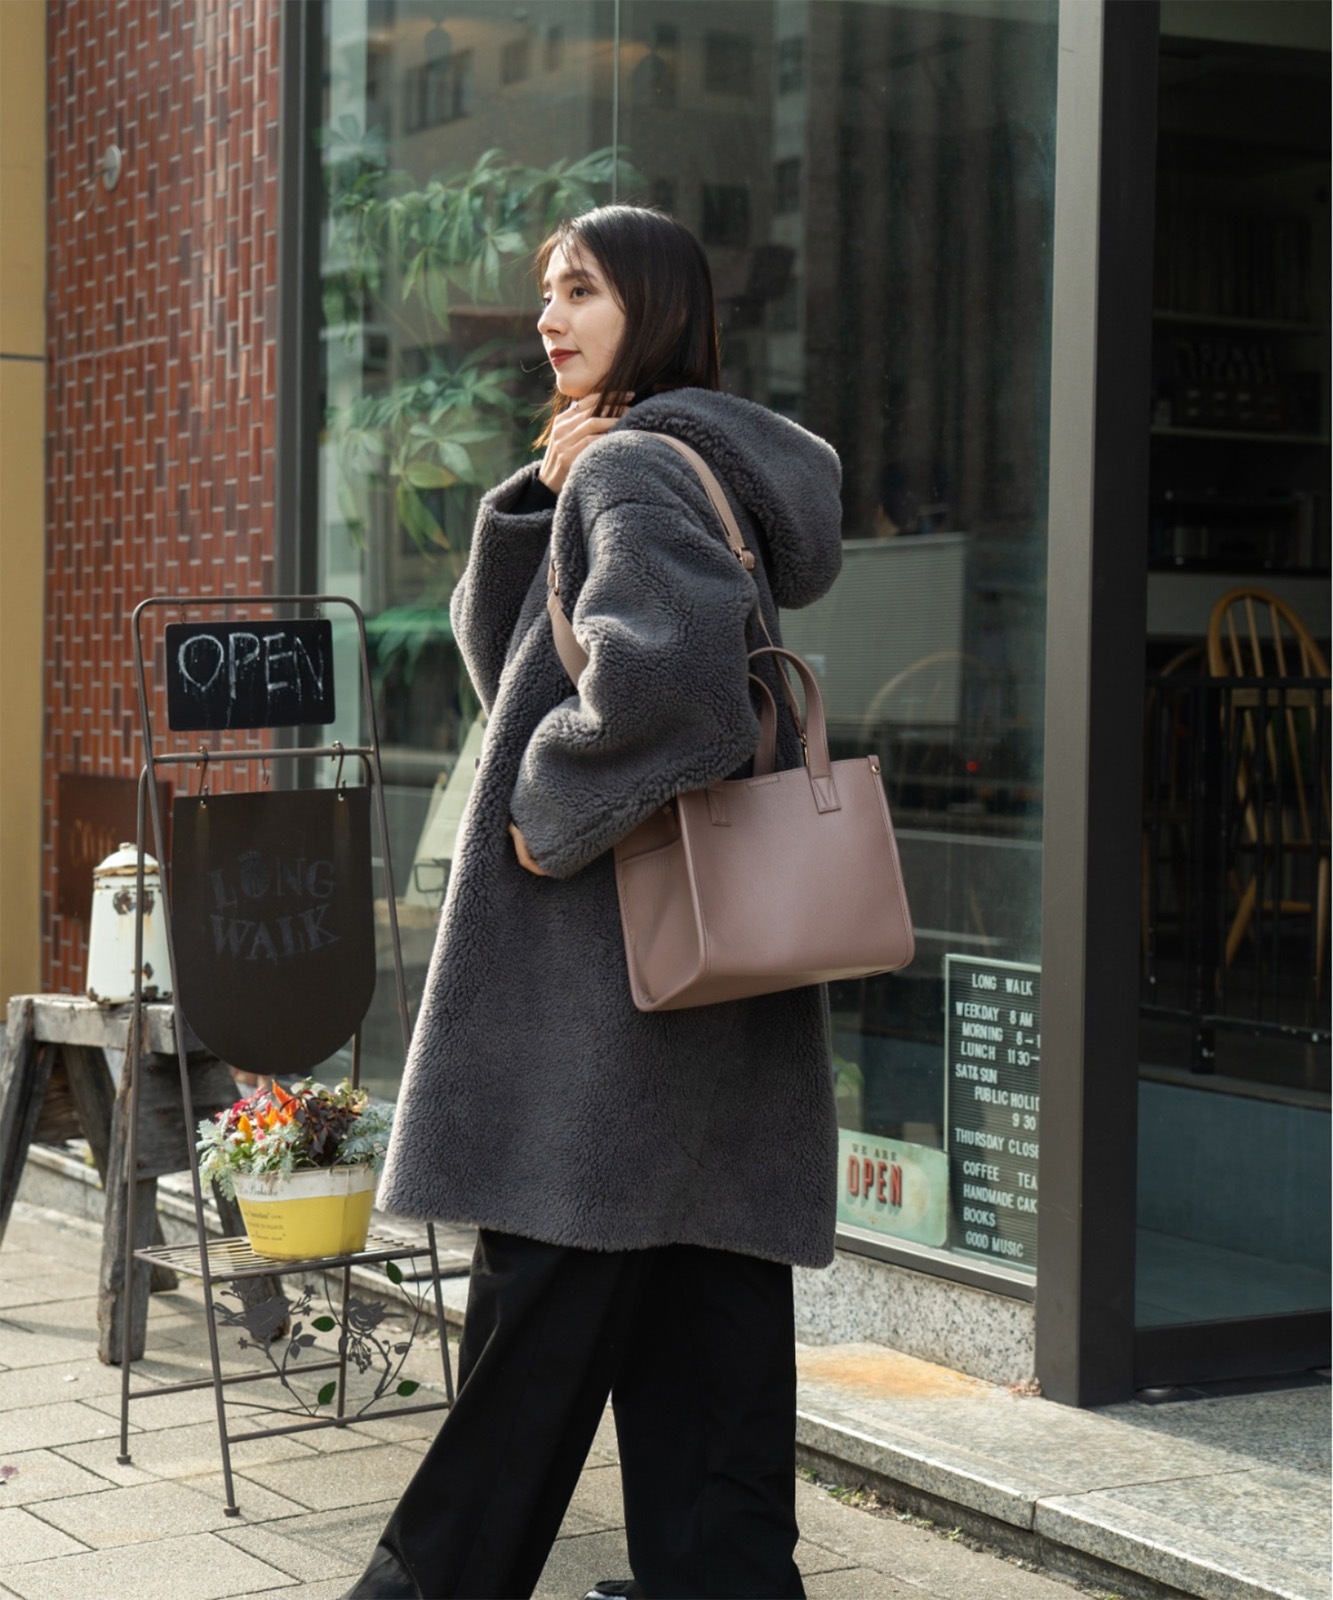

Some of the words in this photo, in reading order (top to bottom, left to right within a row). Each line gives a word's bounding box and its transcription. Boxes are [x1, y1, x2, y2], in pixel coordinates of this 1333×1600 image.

[178, 632, 324, 699] OPEN
[208, 850, 336, 909] LONG
[209, 903, 342, 960] WALK
[972, 973, 997, 990] LONG
[1005, 978, 1033, 996] WALK
[955, 1001, 1000, 1022] WEEKDAY
[1009, 1010, 1016, 1024] 8
[1019, 1012, 1033, 1027] AM
[962, 1022, 1003, 1042] MORNING
[961, 1041, 996, 1060] LUNCH
[974, 1086, 1009, 1106] PUBLIC
[955, 1128, 1005, 1151] THURSDAY
[874, 1148, 897, 1161] ARE
[847, 1155, 902, 1208] OPEN
[963, 1160, 1000, 1181] COFFEE
[1017, 1172, 1038, 1191] TEA
[963, 1184, 1015, 1208] HANDMADE
[963, 1207, 996, 1227] BOOKS
[965, 1231, 989, 1249] GOOD
[992, 1237, 1024, 1257] MUSIC
